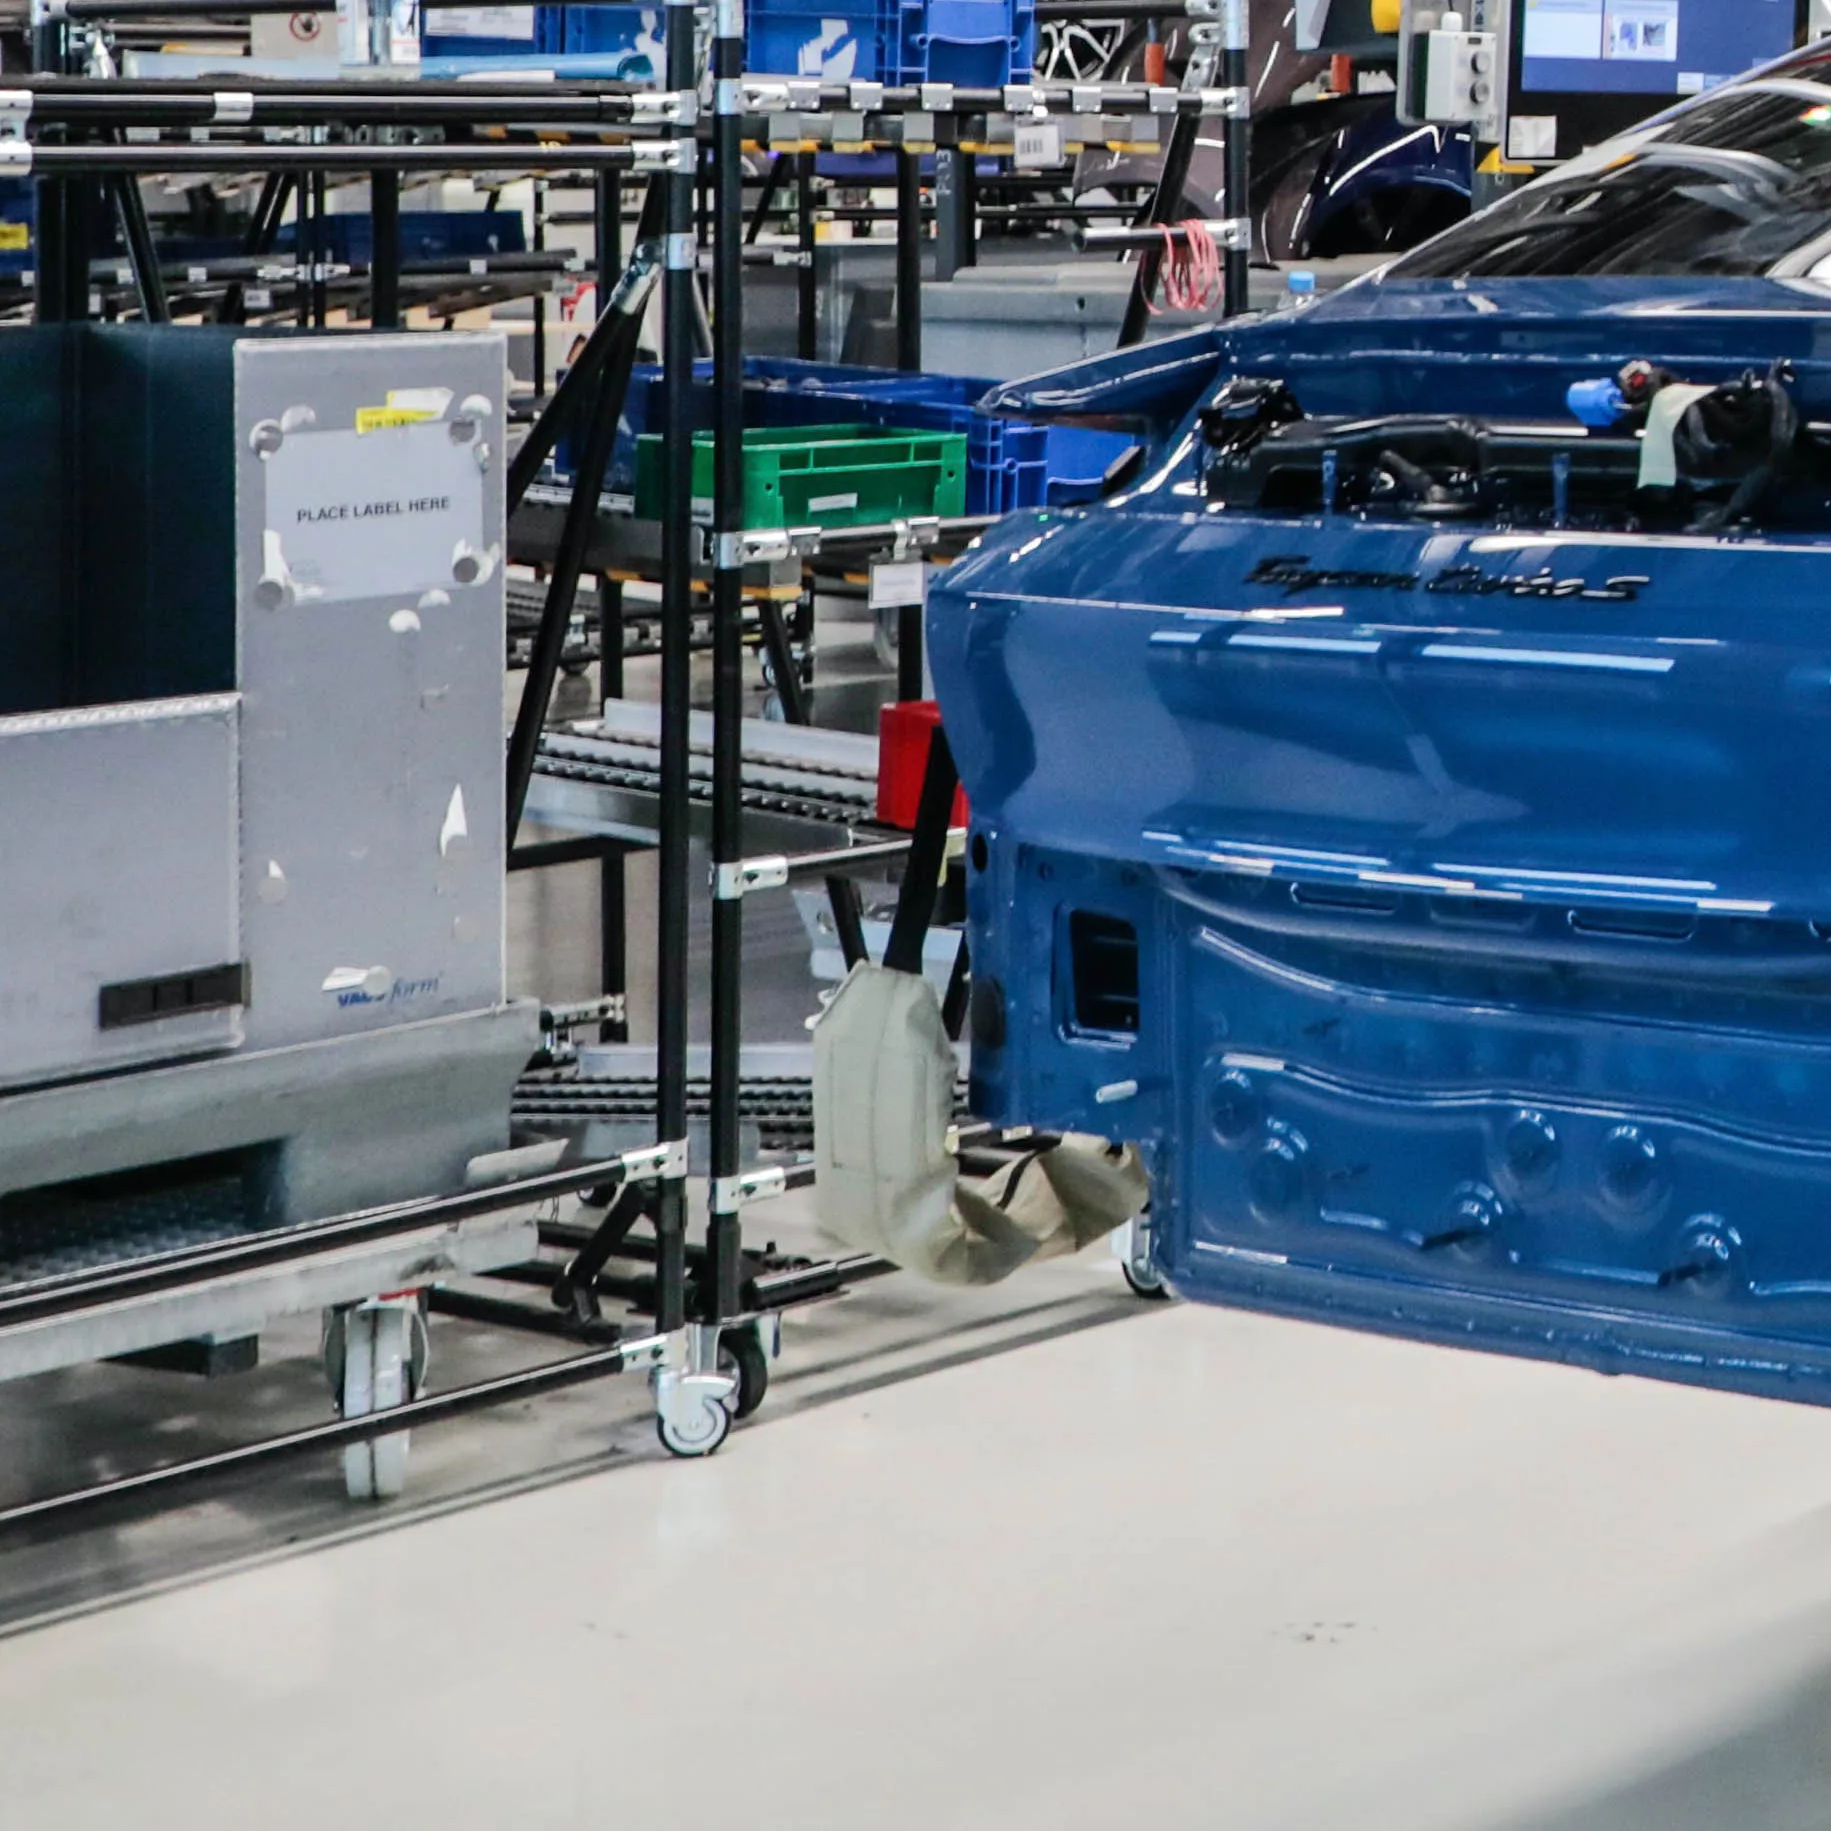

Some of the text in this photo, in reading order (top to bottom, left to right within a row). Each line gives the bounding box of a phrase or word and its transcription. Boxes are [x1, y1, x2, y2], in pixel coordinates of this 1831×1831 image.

[297, 496, 449, 522] PLACE LABEL HERE
